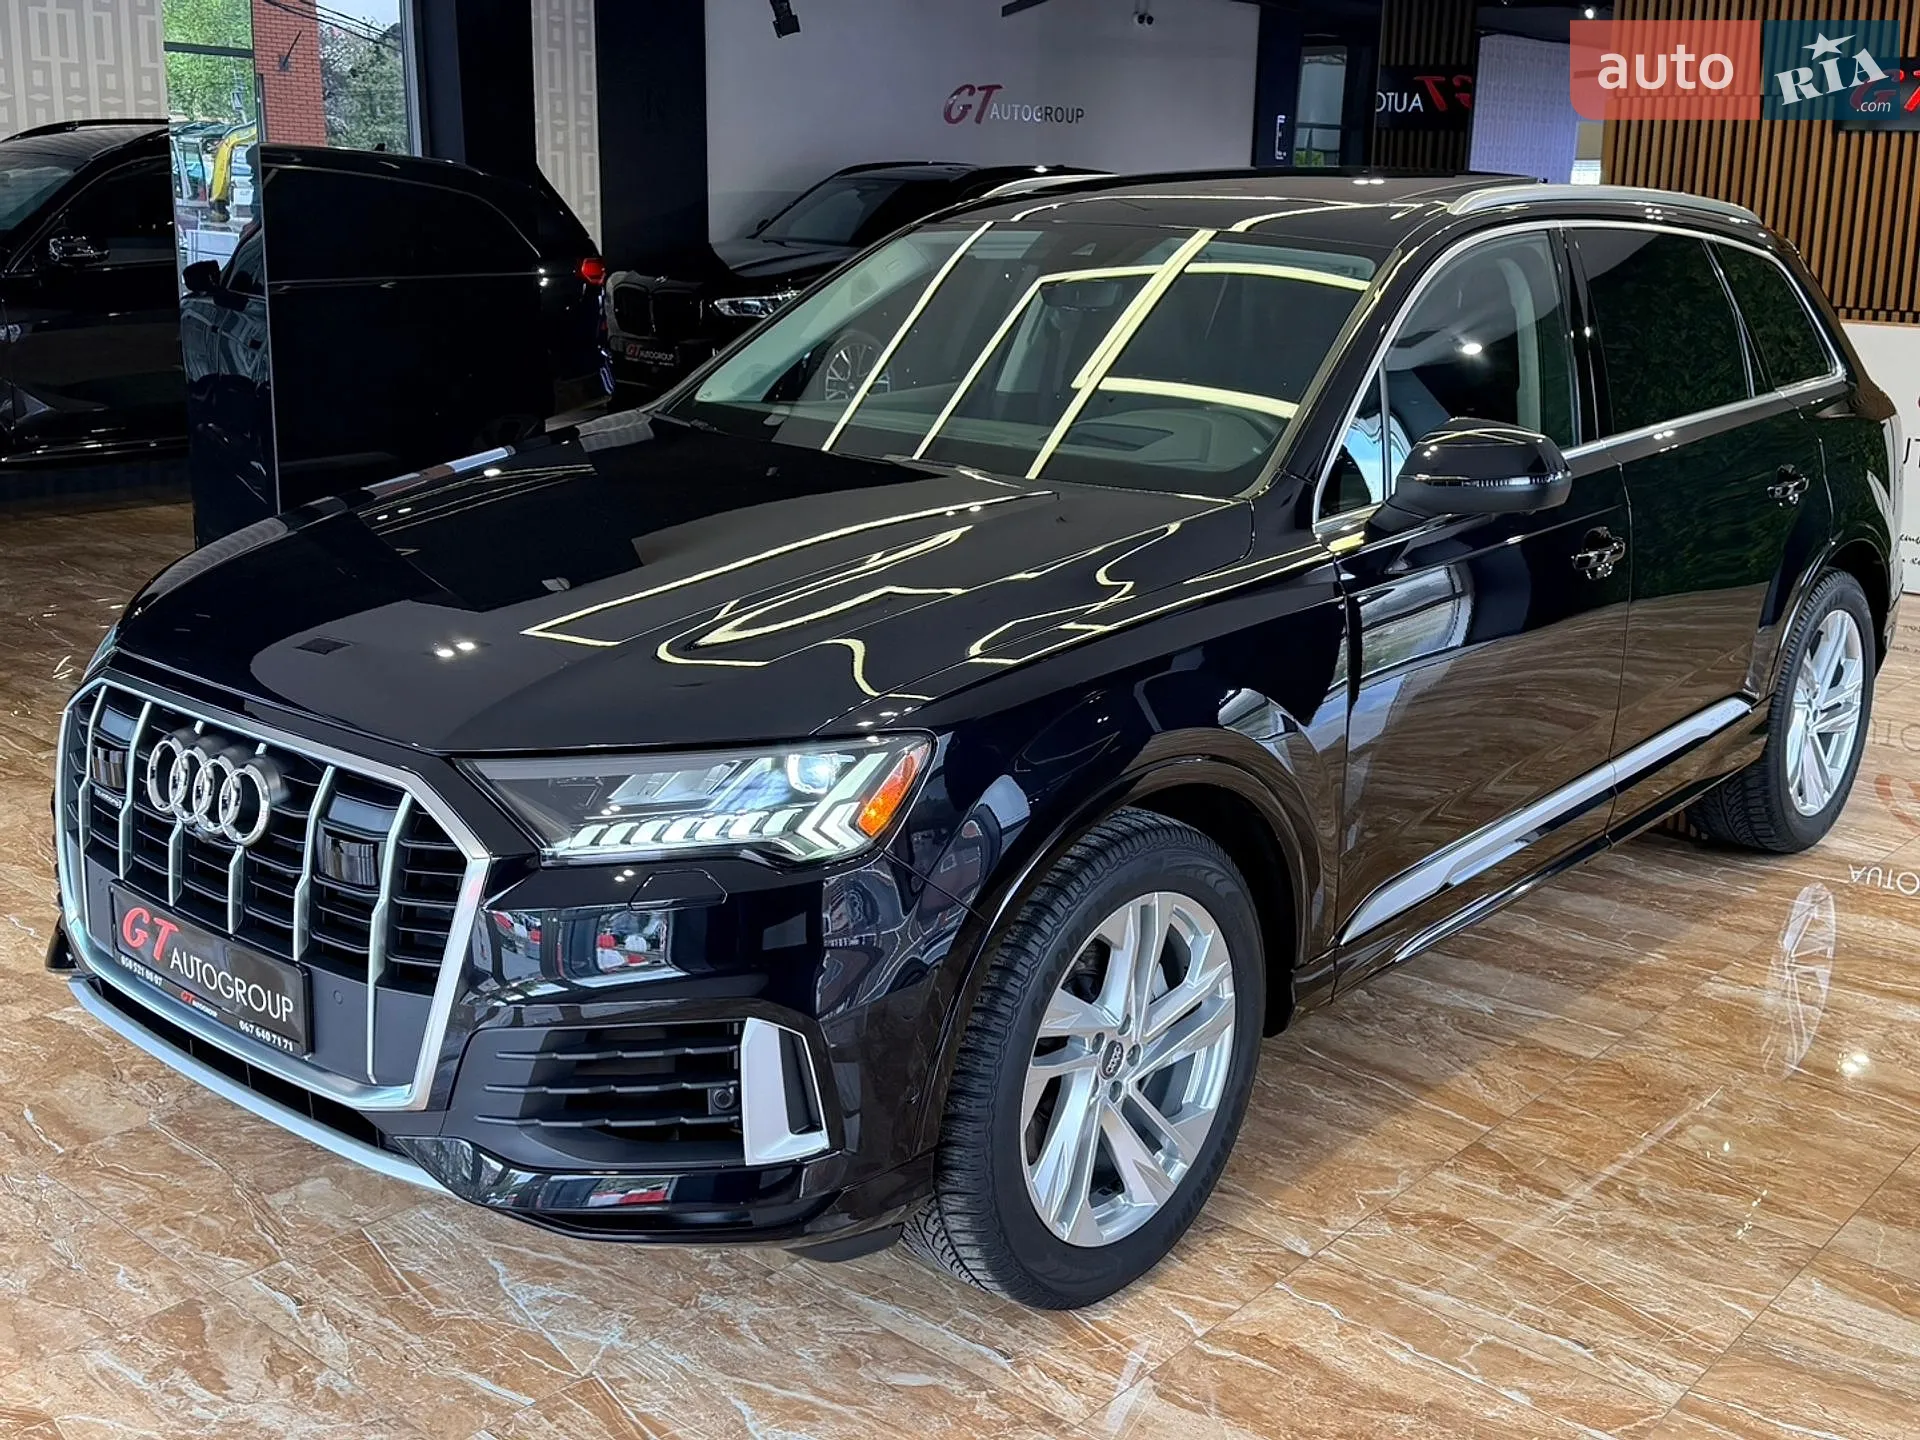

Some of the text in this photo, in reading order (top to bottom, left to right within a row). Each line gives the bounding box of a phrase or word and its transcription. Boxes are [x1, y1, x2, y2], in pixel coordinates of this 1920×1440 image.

[943, 84, 1085, 124] GT AUTOGROUP
[122, 907, 294, 1022] GT AUTOGROUP
